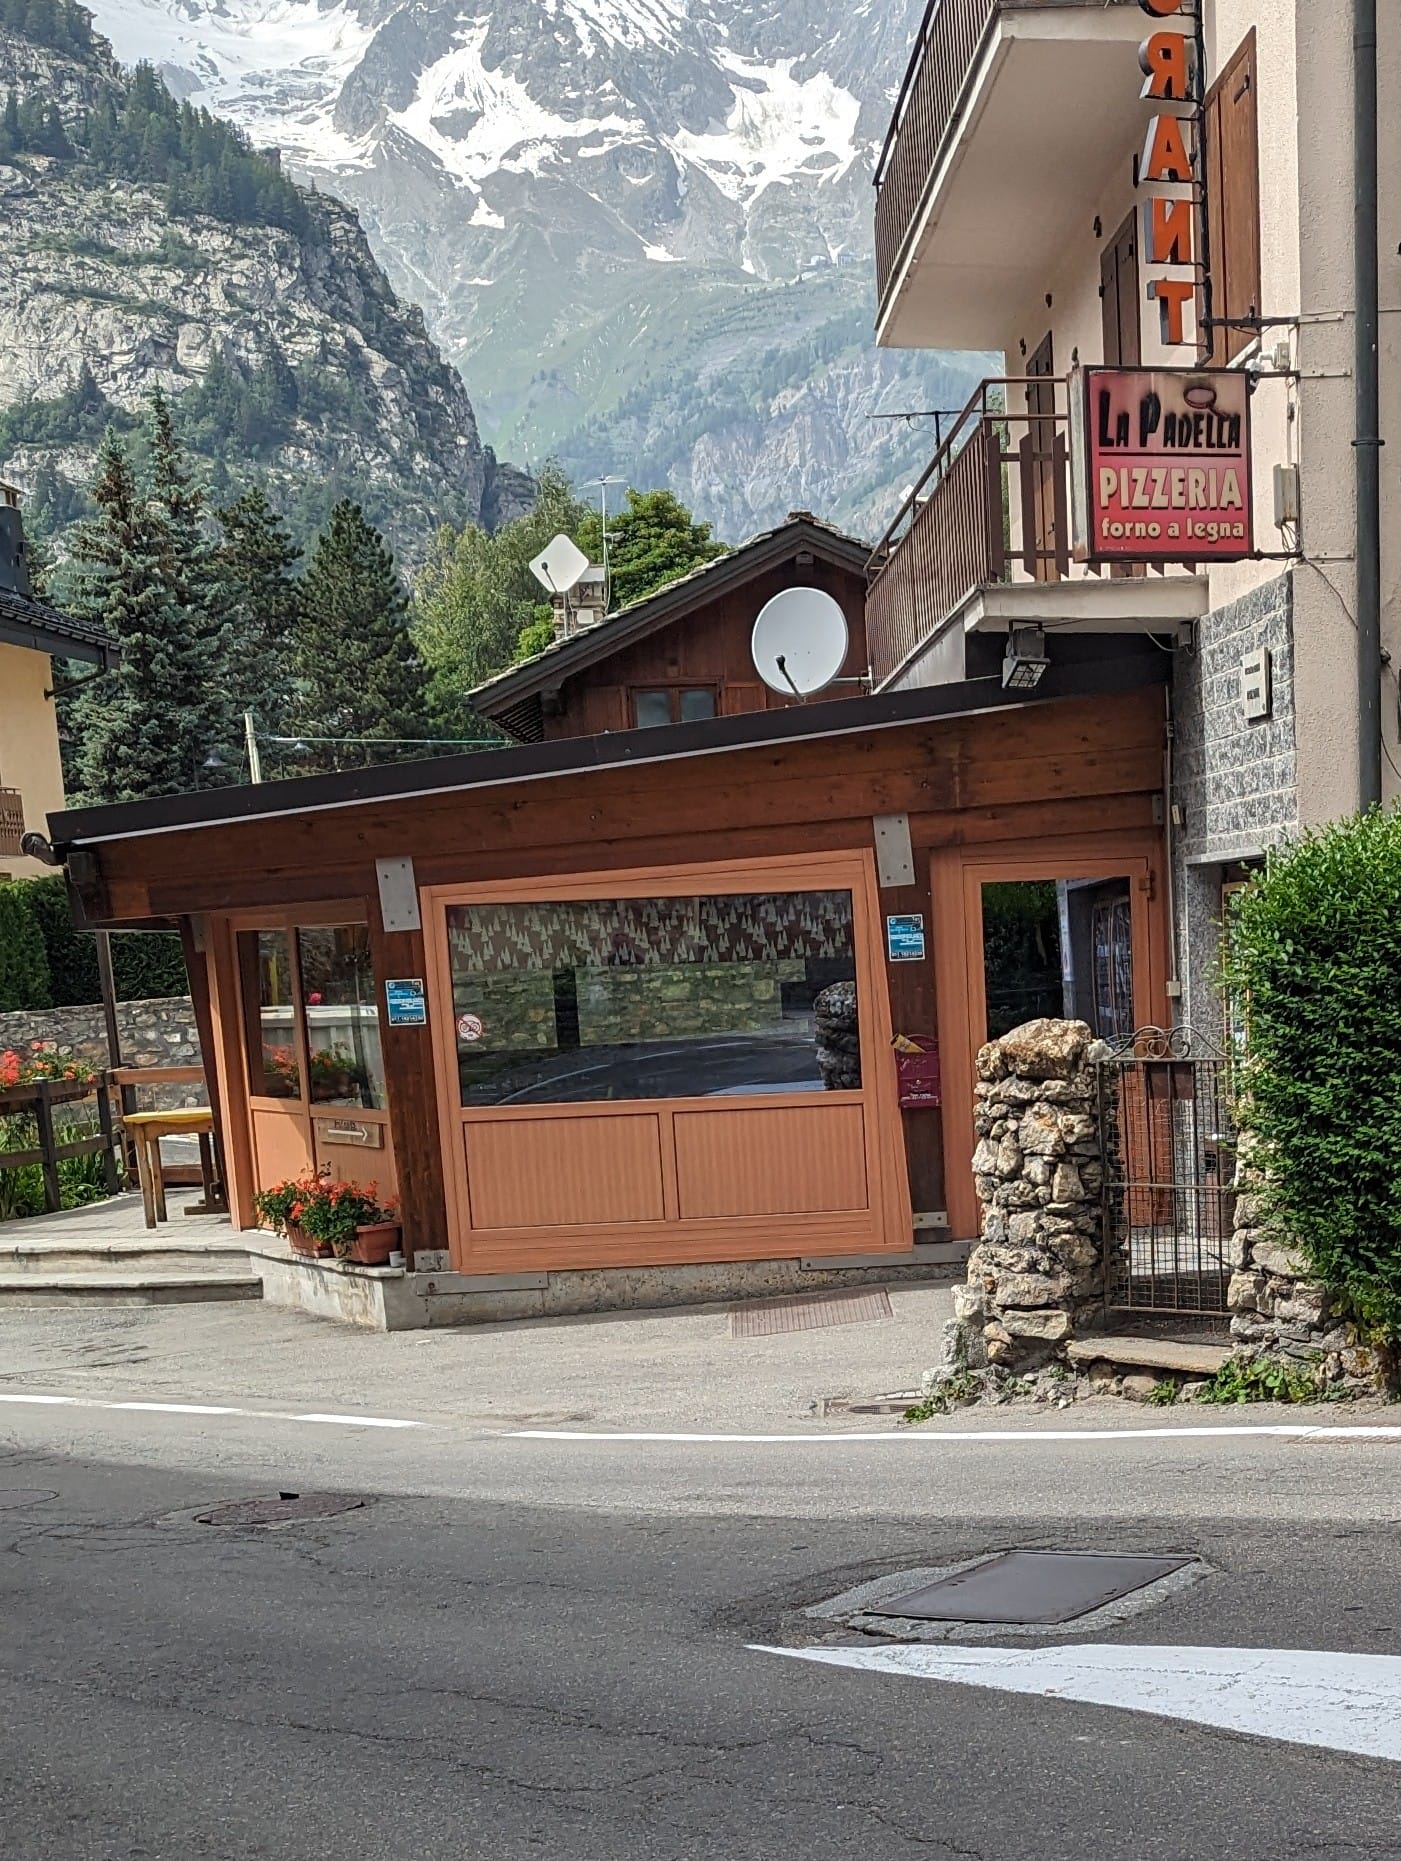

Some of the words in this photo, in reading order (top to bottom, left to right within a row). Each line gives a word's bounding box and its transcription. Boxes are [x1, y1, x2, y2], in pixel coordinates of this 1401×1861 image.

[1099, 467, 1243, 511] PIZZERIA
[1101, 517, 1161, 540] forno
[1167, 521, 1180, 540] a
[1186, 517, 1244, 544] legna
